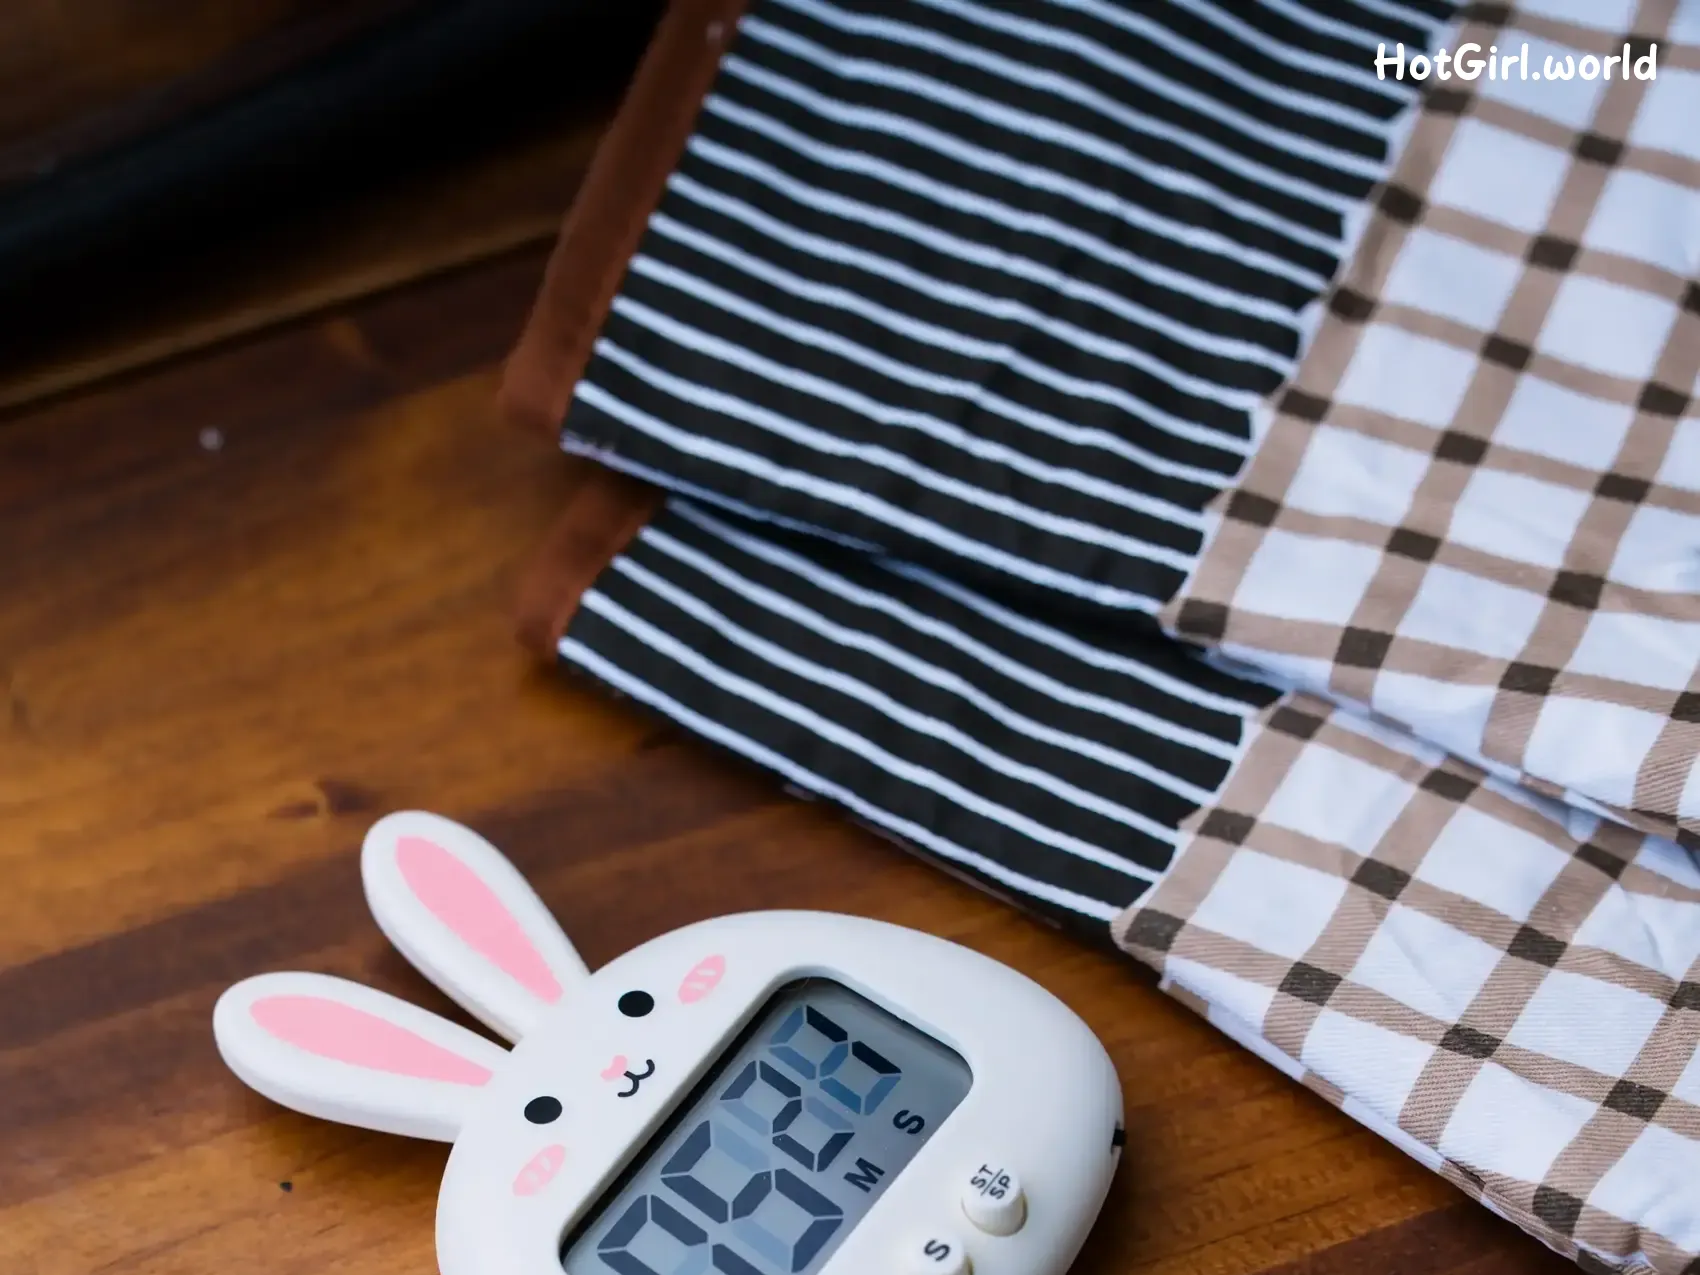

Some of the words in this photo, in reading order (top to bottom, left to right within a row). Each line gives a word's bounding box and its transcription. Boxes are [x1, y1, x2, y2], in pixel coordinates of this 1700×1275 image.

[843, 1157, 886, 1194] M
[892, 1109, 926, 1135] S
[970, 1163, 993, 1190] ST
[989, 1174, 1011, 1201] SP
[923, 1238, 951, 1262] S
